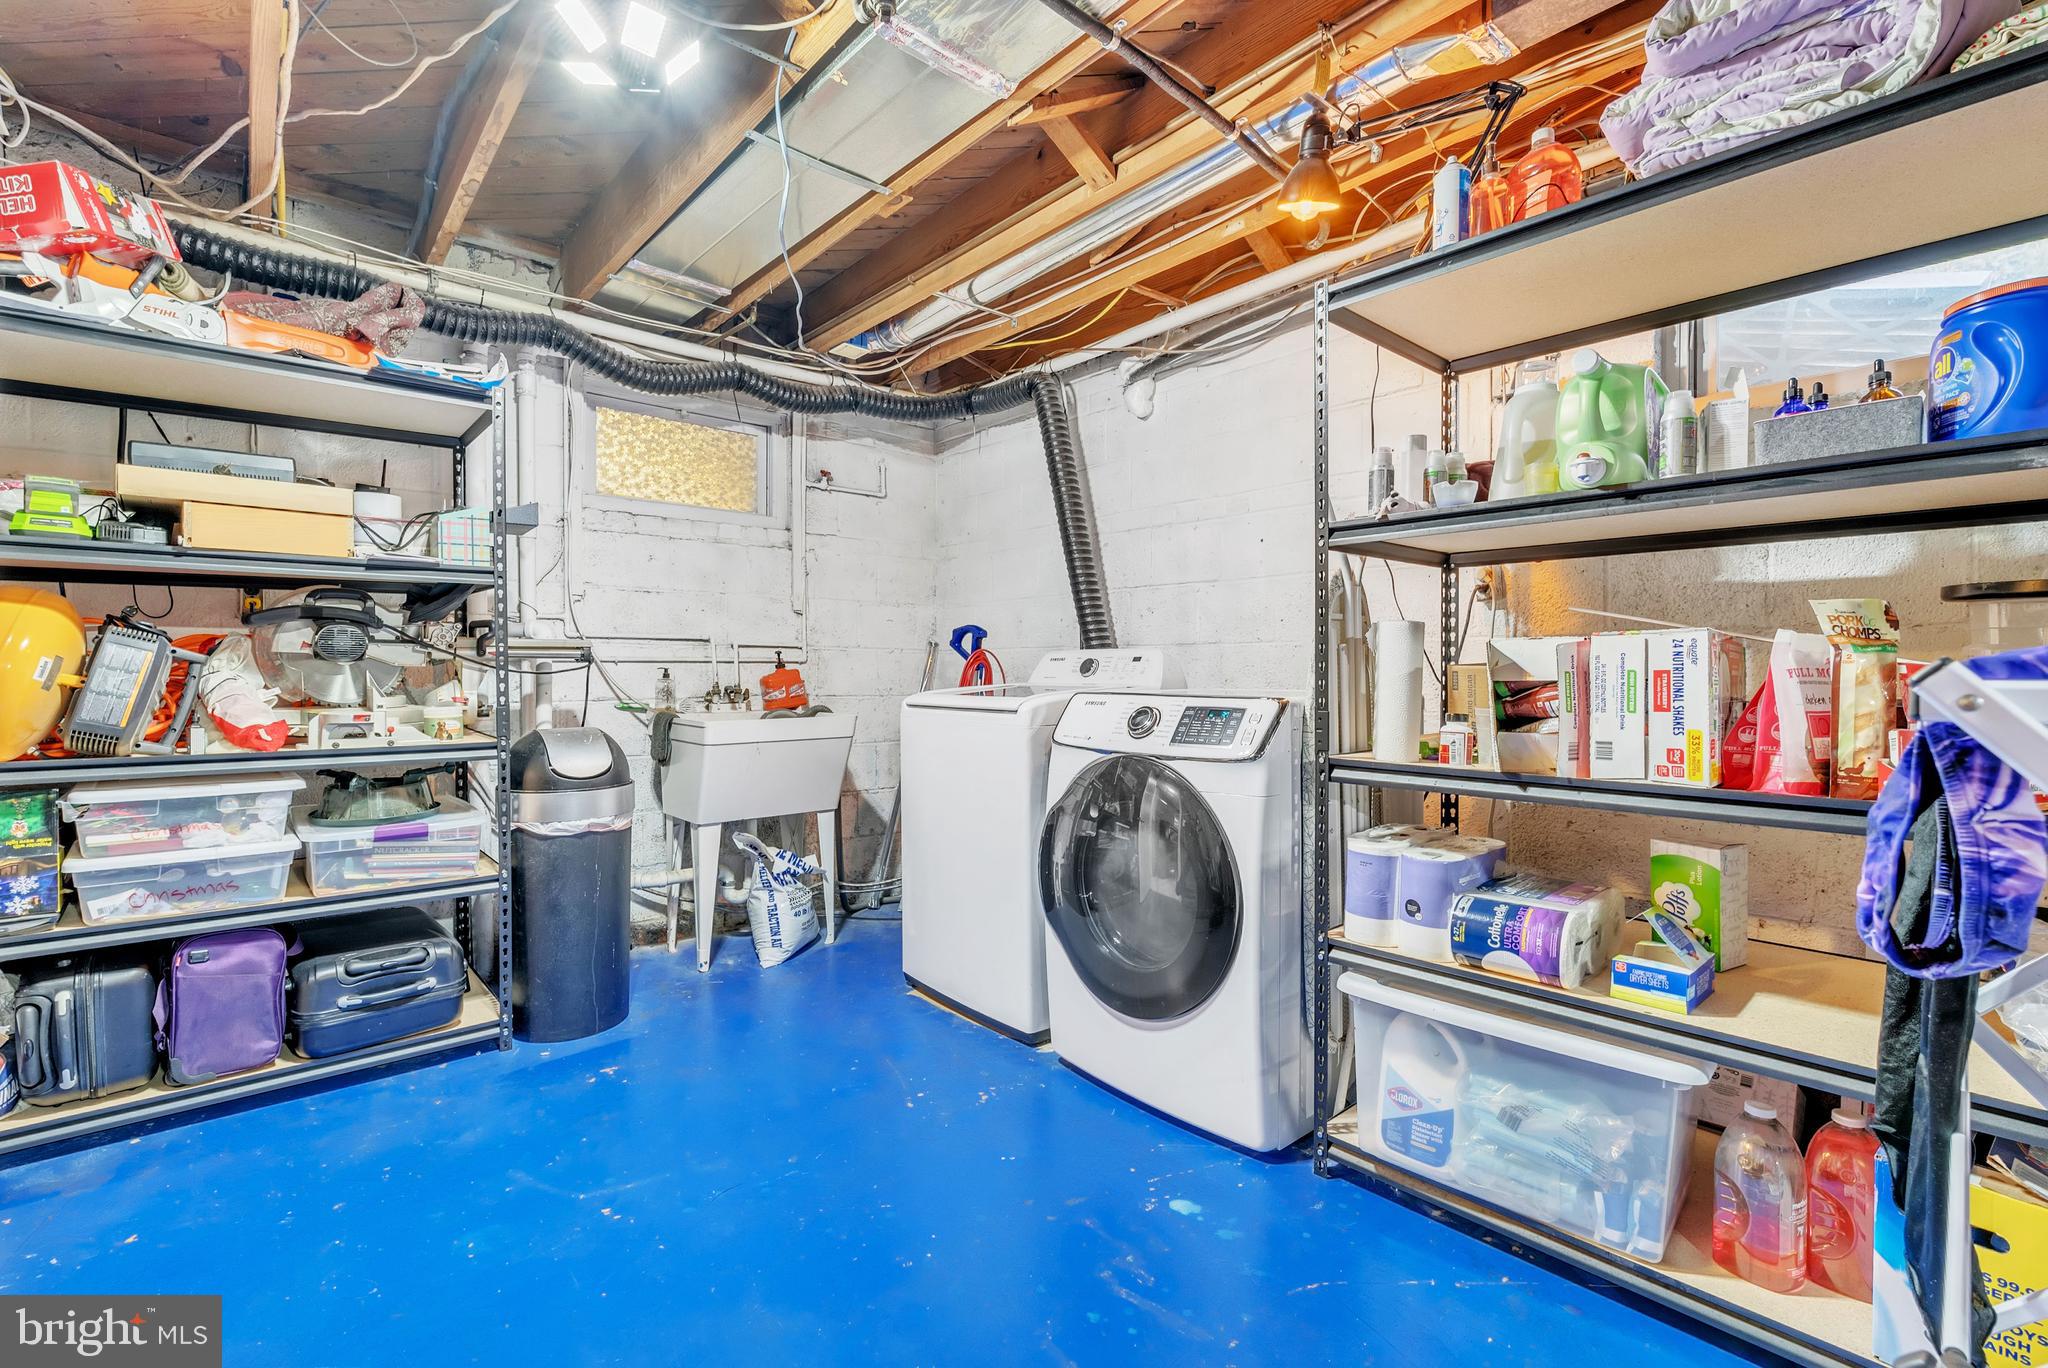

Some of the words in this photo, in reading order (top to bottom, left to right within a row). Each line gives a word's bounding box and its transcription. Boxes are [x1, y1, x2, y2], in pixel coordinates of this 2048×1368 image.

[142, 304, 180, 319] STIHL
[1935, 353, 1951, 380] all
[1826, 614, 1863, 627] PORK
[1832, 624, 1881, 640] CHOMPS
[1672, 639, 1684, 648] 24
[1689, 637, 1698, 666] equate
[1672, 651, 1684, 703] NUTRITIONAL
[1786, 667, 1814, 679] FULL
[1672, 705, 1685, 736] SHAKES
[1691, 735, 1701, 754] 33%
[374, 845, 431, 855] NUTCRACKER
[767, 889, 775, 906] AND
[1661, 888, 1690, 923] Puffs
[767, 903, 781, 937] TRACTION
[1487, 903, 1510, 949] Cottonelle
[1512, 906, 1529, 951] COMFORT
[1504, 920, 1515, 949] ULTRA
[1629, 974, 1648, 985] DRYER
[1648, 977, 1670, 990] SHEETS
[1390, 1089, 1418, 1109] CLOROX
[1983, 1341, 2032, 1366] AINS
